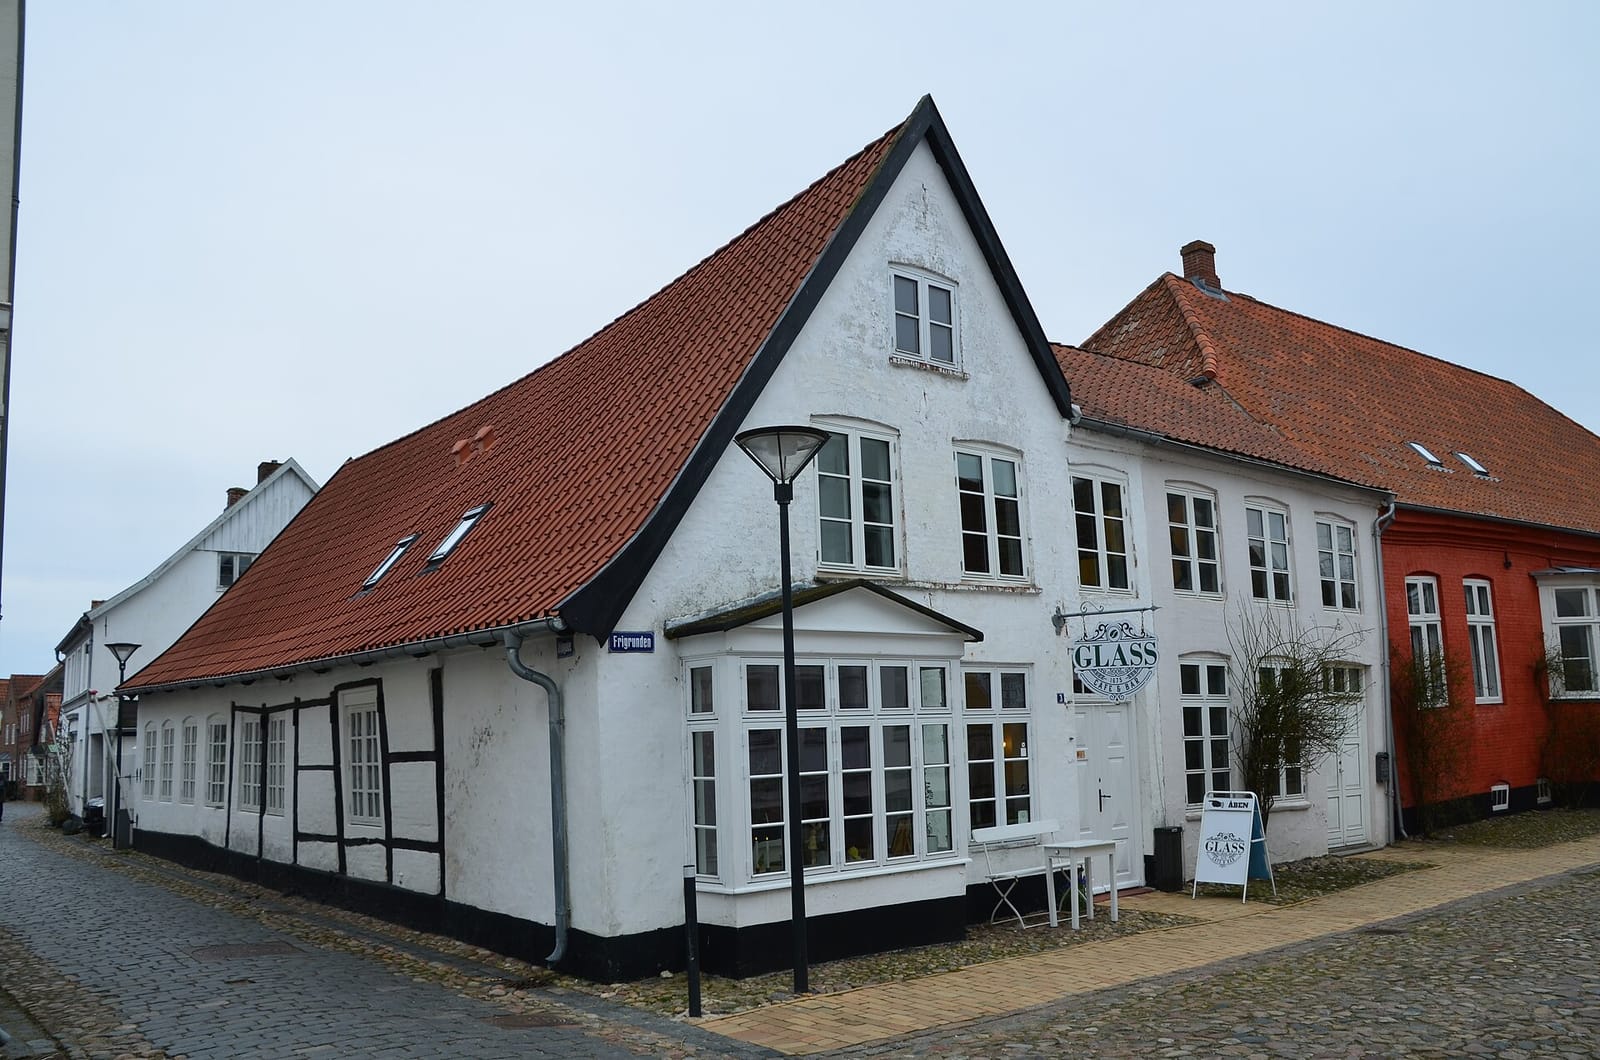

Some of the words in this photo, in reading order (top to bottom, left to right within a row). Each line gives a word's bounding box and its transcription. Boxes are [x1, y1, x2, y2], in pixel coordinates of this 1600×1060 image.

[613, 635, 652, 649] Frigrunden
[1074, 642, 1158, 668] GLASS
[1125, 677, 1140, 690] BAR
[1228, 800, 1248, 808] ÅBEN
[1205, 841, 1245, 854] GLASS
